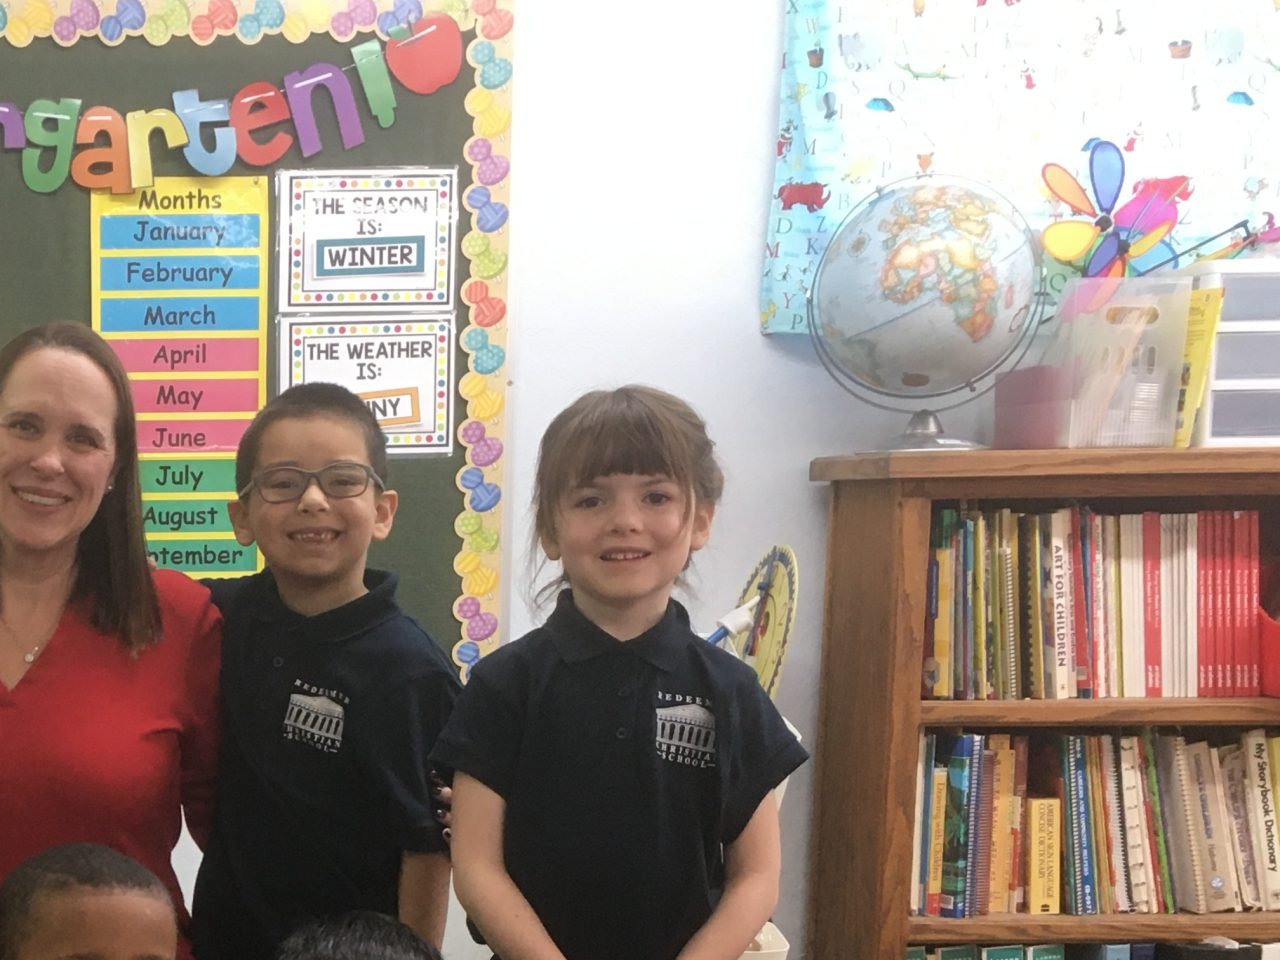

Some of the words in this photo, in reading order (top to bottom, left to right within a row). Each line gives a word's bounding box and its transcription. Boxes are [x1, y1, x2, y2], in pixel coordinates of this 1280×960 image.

[138, 190, 222, 211] Months
[313, 197, 345, 215] THE
[352, 196, 428, 214] SEASON
[133, 220, 225, 246] January
[356, 218, 382, 235] IS:
[328, 245, 413, 267] WINTER
[126, 263, 233, 287] February
[144, 306, 216, 326] March
[153, 344, 207, 369] April
[307, 342, 340, 361] THE
[347, 341, 433, 361] WEATHER
[356, 362, 382, 381] IS:
[156, 385, 203, 410] May
[152, 427, 206, 447] June
[155, 465, 204, 490] July
[144, 506, 218, 531] August
[1054, 545, 1063, 569] ART
[1055, 574, 1064, 599] FOR
[1056, 603, 1066, 667] CHILDREN
[1254, 743, 1265, 759] My
[1257, 762, 1273, 816] Storybook
[1265, 820, 1279, 872] Dictionary
[932, 843, 943, 881] Children
